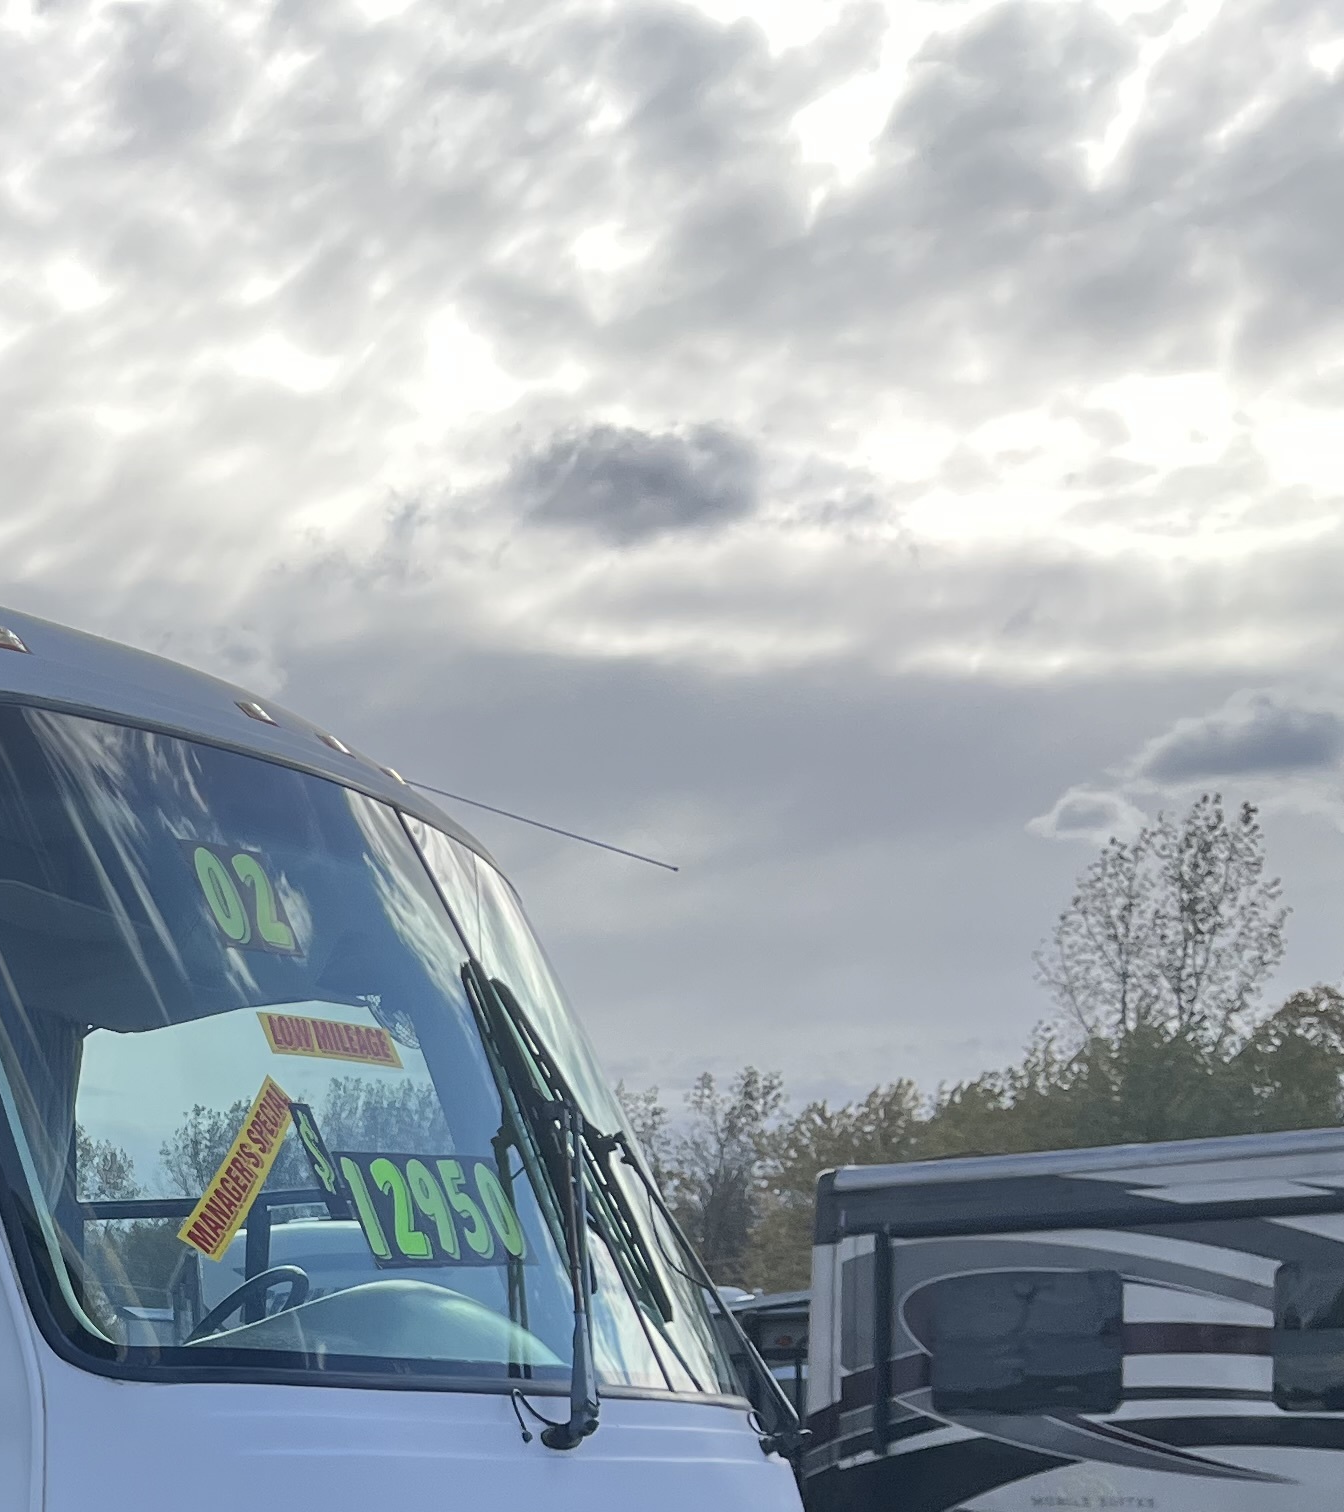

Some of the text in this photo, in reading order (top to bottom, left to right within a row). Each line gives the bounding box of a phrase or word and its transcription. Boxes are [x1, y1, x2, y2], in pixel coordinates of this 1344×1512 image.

[194, 847, 295, 950] 02
[268, 1015, 395, 1063] LOW MILEAGE
[186, 1081, 292, 1256] MANAGER'S SPECIAL
[340, 1156, 528, 1260] 12950
